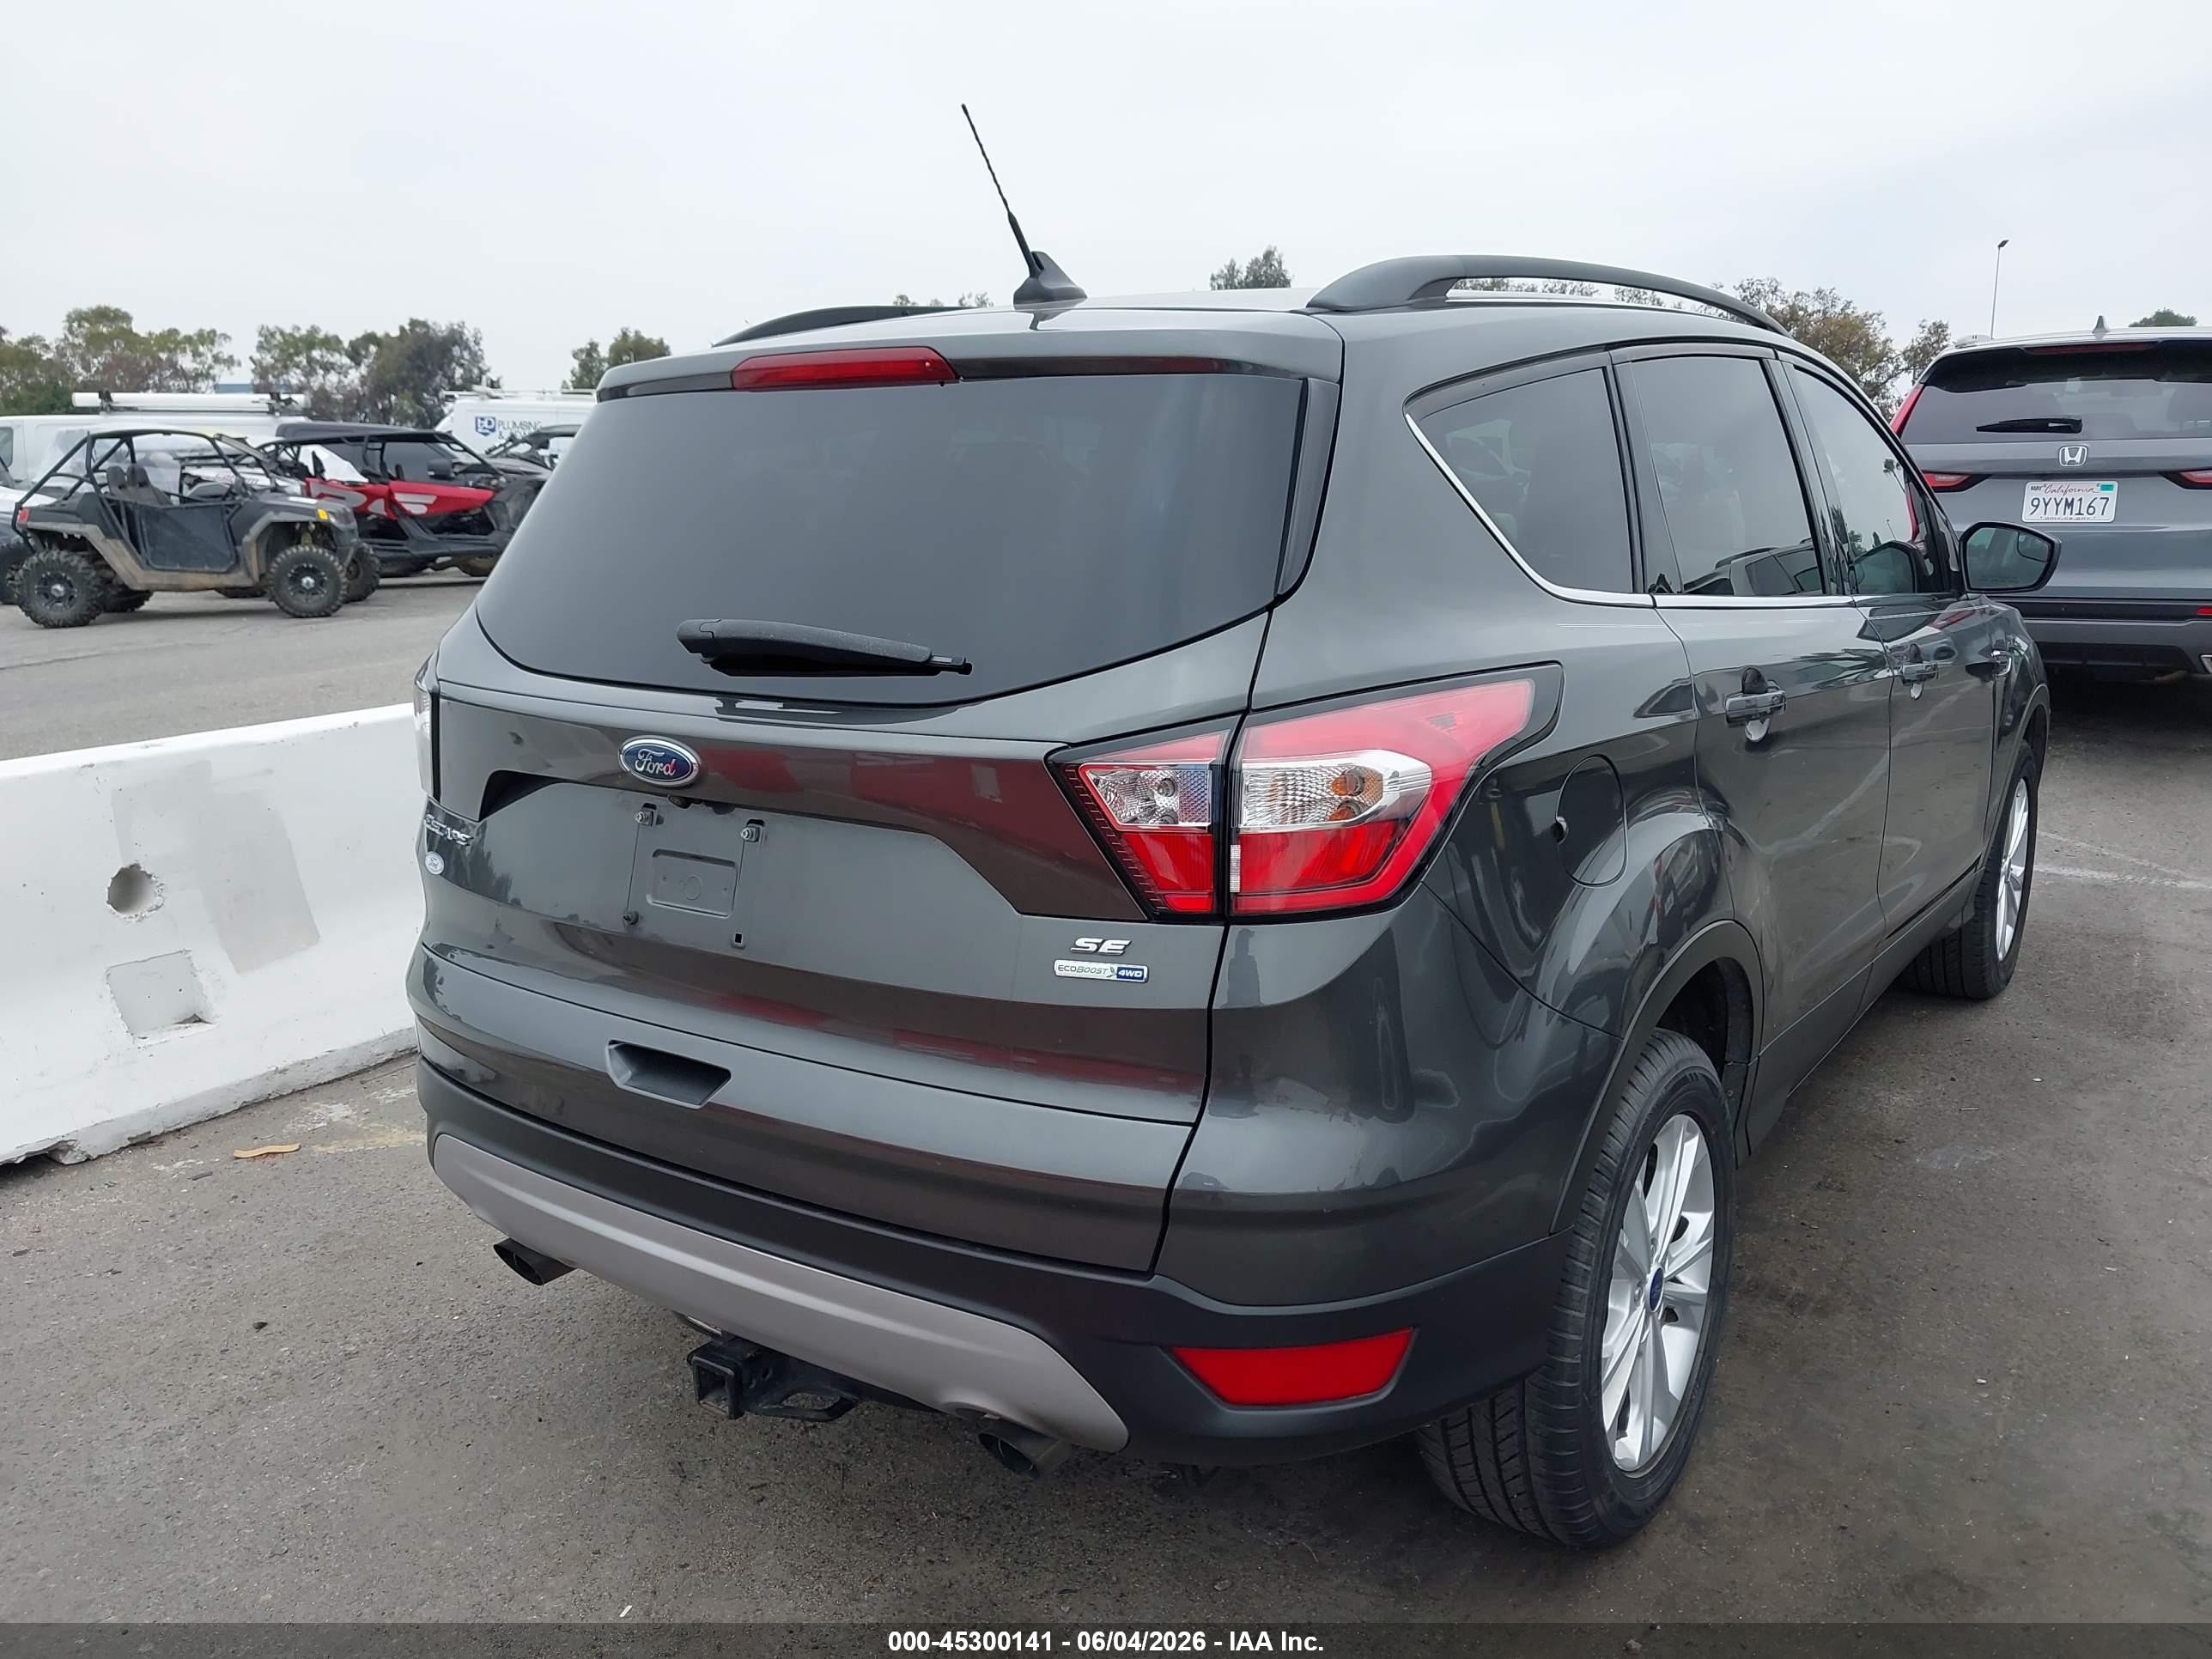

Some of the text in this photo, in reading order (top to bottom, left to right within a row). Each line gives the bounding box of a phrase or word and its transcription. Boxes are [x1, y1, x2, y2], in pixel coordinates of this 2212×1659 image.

[2044, 483, 2099, 496] California
[2029, 497, 2110, 516] 9YYM167
[635, 748, 677, 776] Ford
[1070, 937, 1133, 956] SE
[1057, 964, 1143, 978] ECOBOOST 4WD
